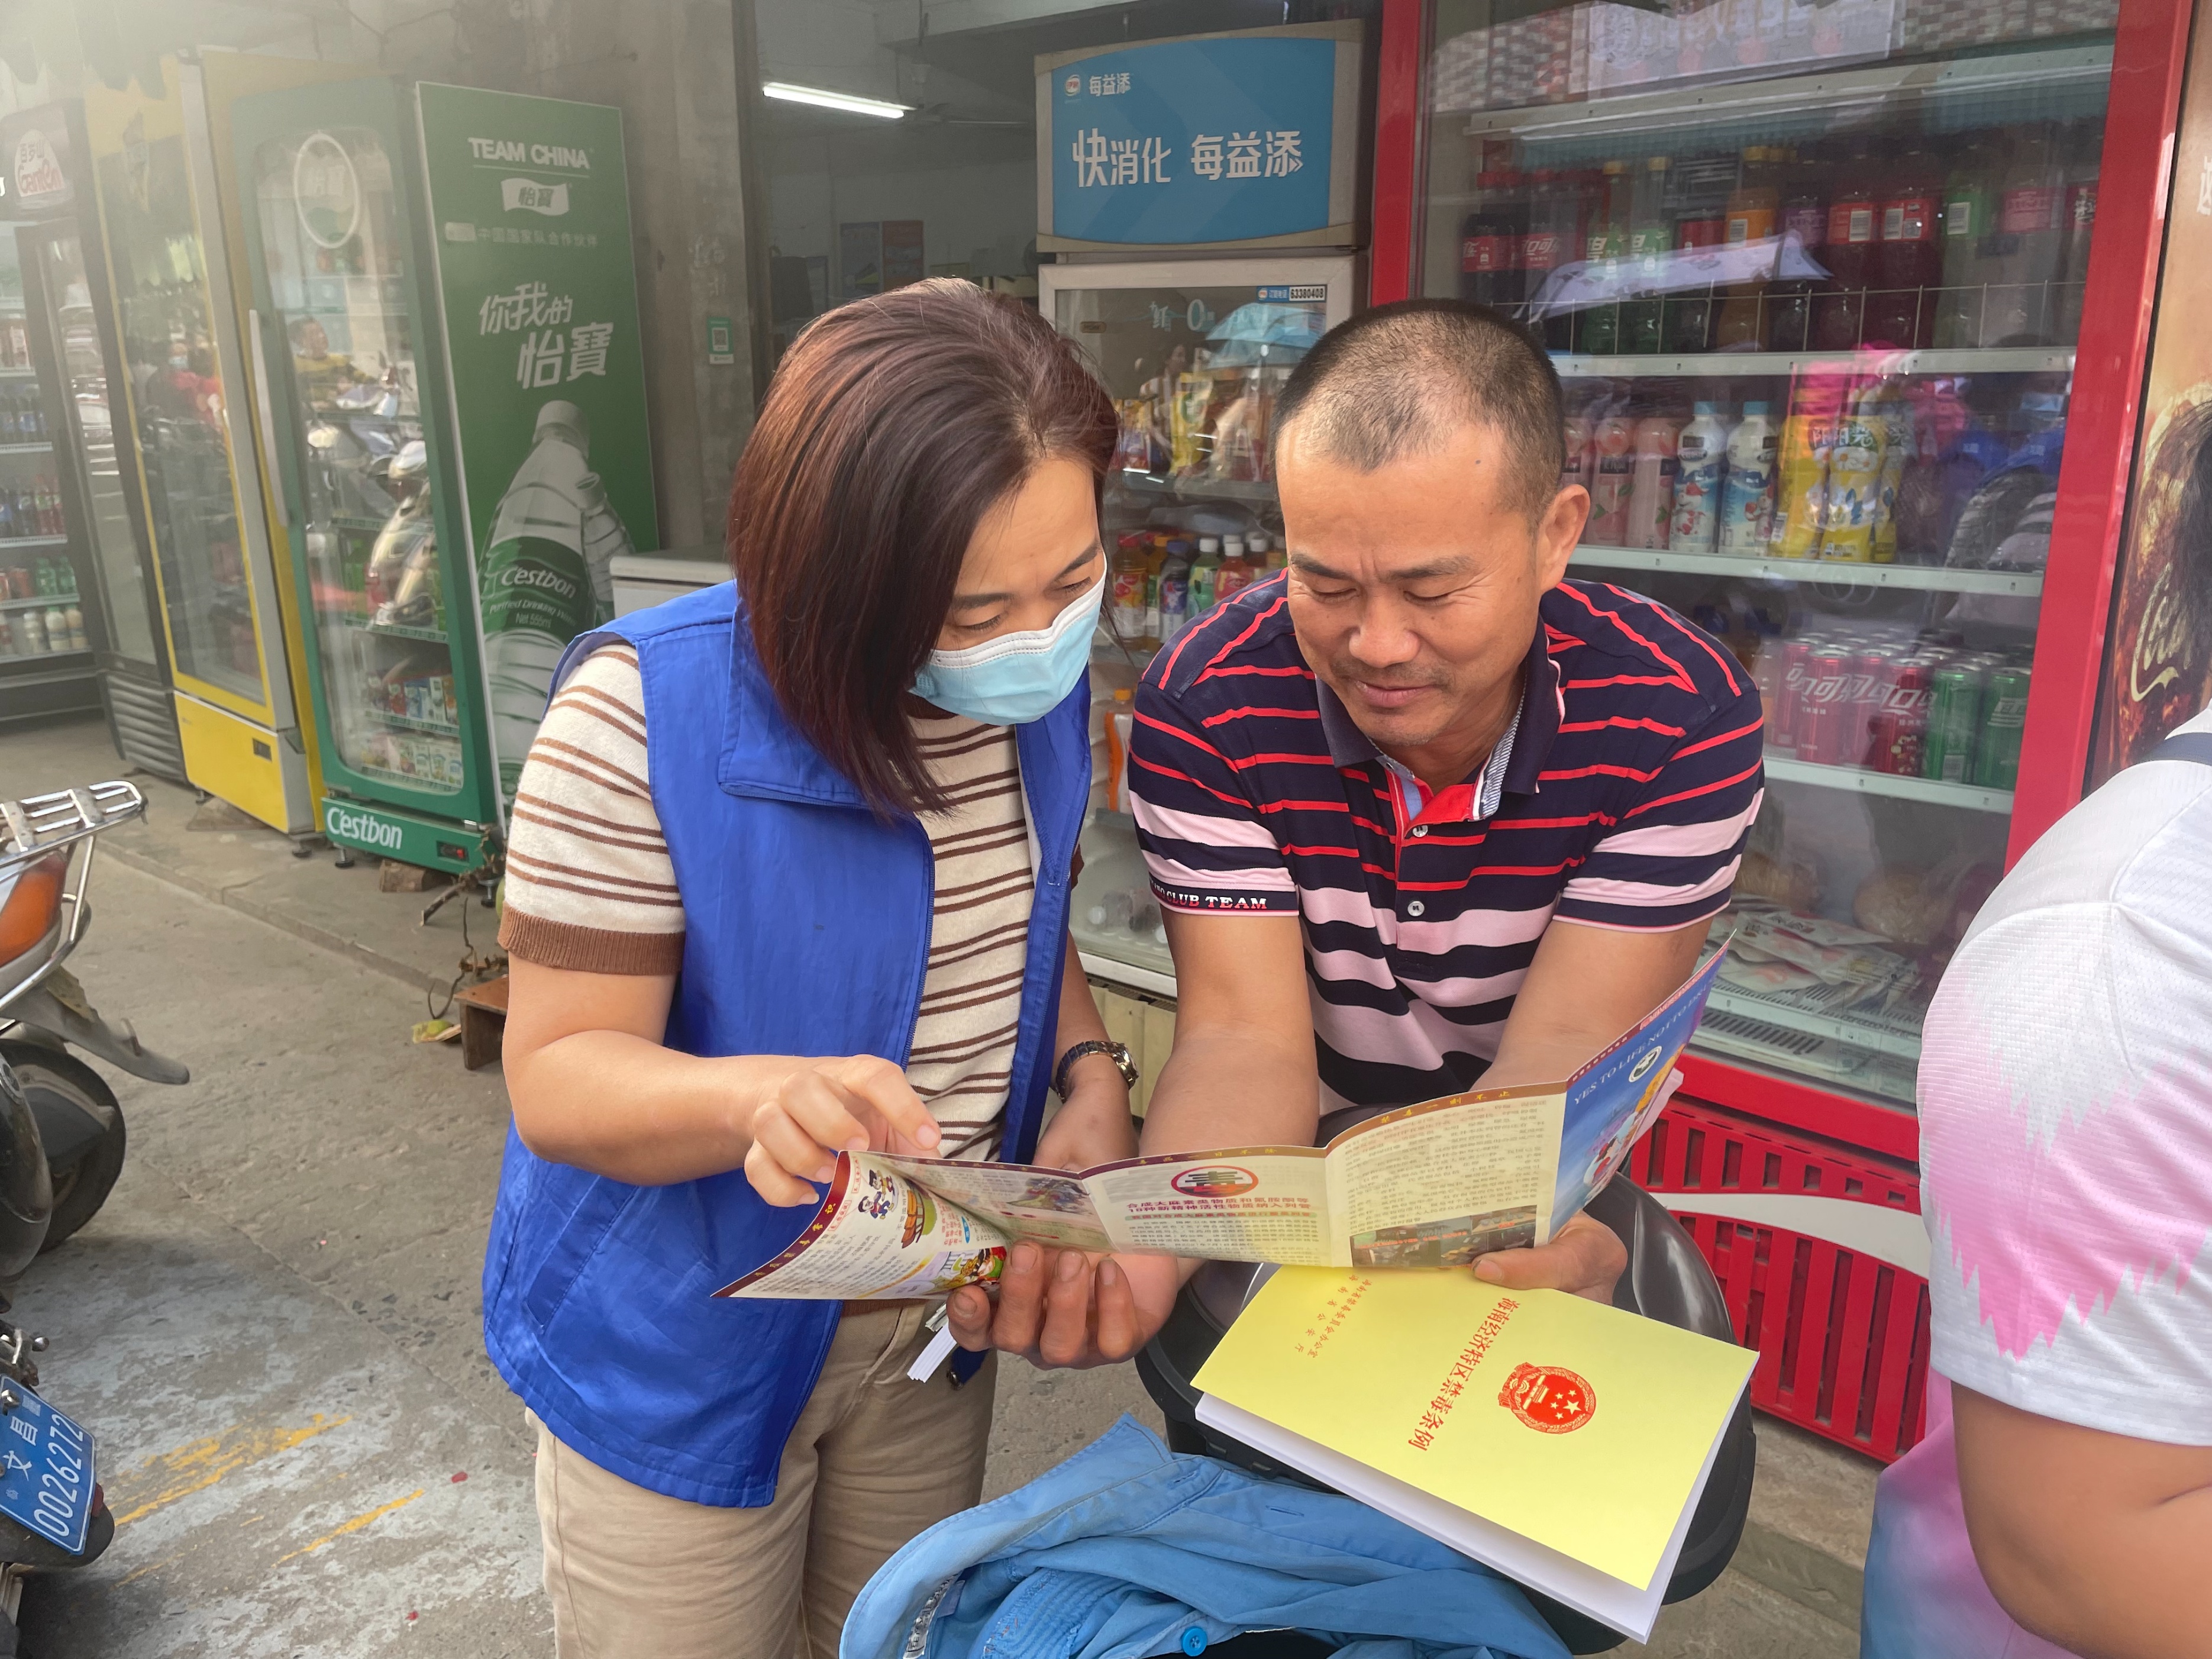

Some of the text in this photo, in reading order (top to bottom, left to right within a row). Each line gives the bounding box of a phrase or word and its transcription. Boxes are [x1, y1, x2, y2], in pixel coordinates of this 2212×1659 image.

[1089, 72, 1131, 97] 每益添
[467, 137, 590, 170] TEAM CHINA
[1071, 127, 1303, 188] 快消化 每益添
[518, 186, 554, 208] 怡寶
[479, 280, 573, 336] 你我的
[516, 321, 614, 390] 怡寶
[327, 806, 403, 850] C'estbon
[1166, 890, 1268, 910] CLUB TEAM
[1574, 1082, 1597, 1105] YES
[1600, 1067, 1617, 1083] TO
[1619, 1042, 1646, 1070] LIFE
[1407, 1297, 1521, 1451] 海南经济特区禁毒条例
[34, 1413, 83, 1537] 0026272
